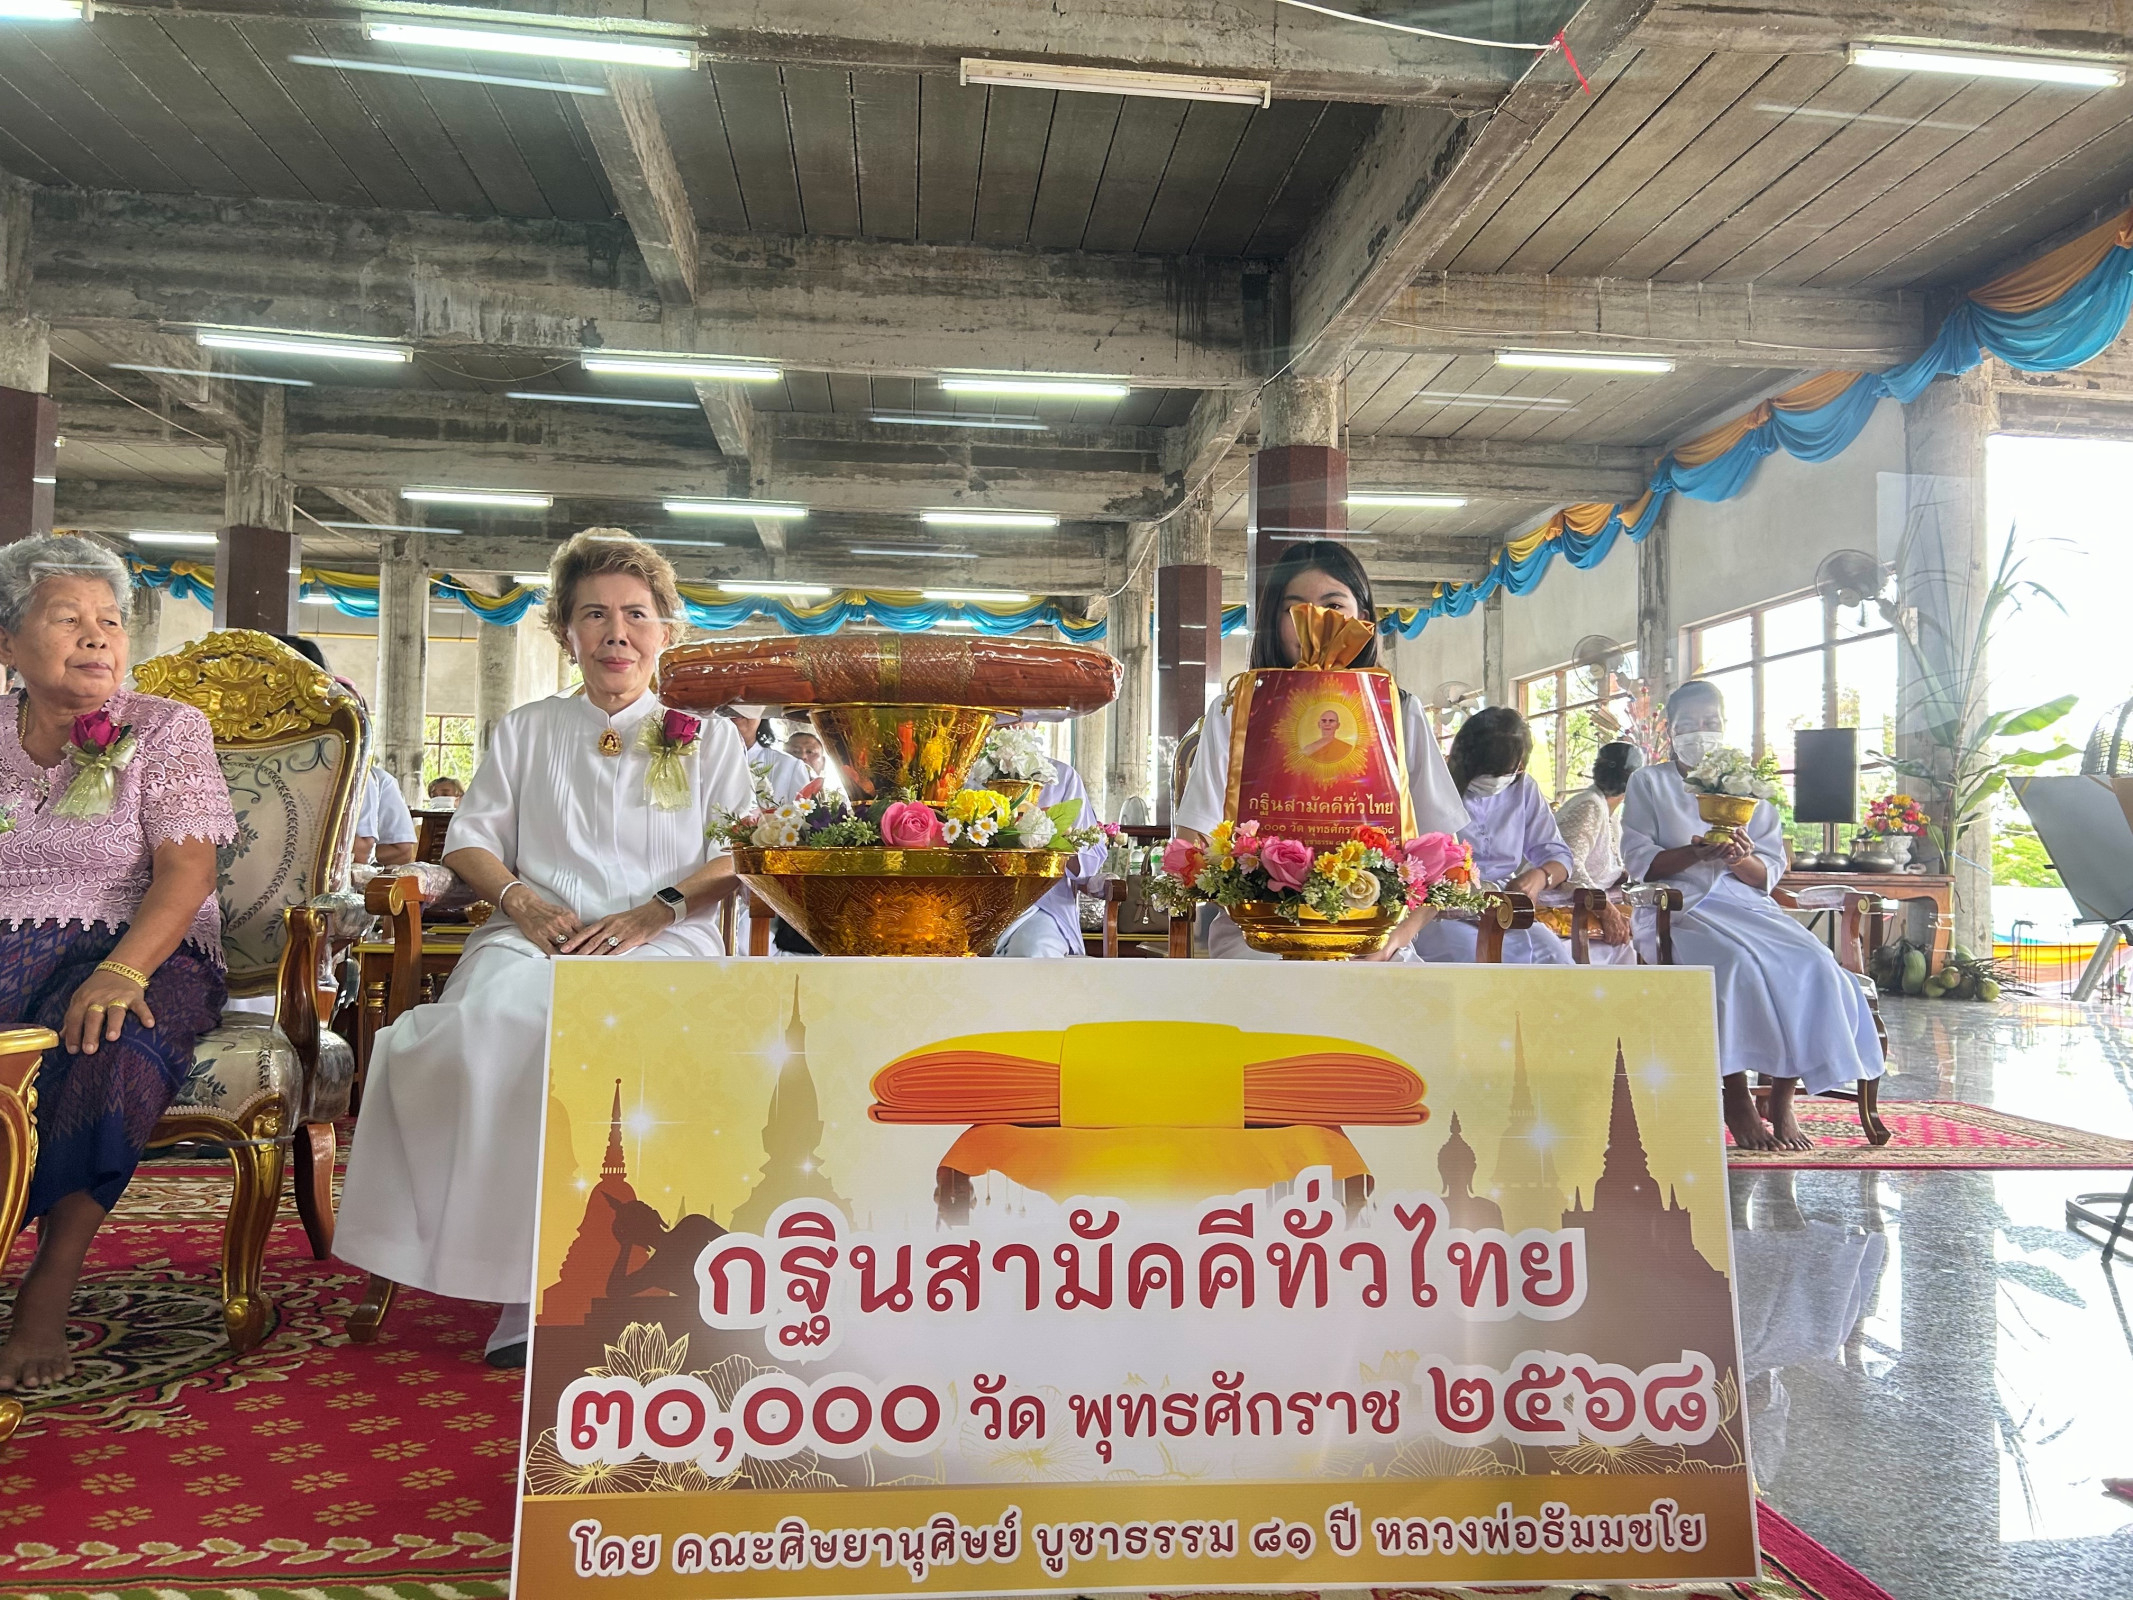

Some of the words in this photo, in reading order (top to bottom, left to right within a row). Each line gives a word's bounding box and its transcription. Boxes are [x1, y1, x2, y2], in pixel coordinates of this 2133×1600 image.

[1249, 792, 1394, 816] กฐินสามัคคีทั่วไทย
[1289, 821, 1304, 833] วัด
[708, 1179, 1574, 1347] กฐินสามัคคีทั่วไทย
[569, 1384, 942, 1463] ๓๐,๐๐๐
[970, 1373, 1047, 1440] วัด
[1068, 1370, 1401, 1464] พุทธศักราช
[1426, 1362, 1708, 1434] ๒๕๖๘
[574, 1524, 656, 1571] โดย
[677, 1511, 1018, 1575] คณะศิษยานุศิษย์
[1037, 1525, 1234, 1573] บูชาธรรม
[1253, 1523, 1311, 1554] ๘๑
[1330, 1507, 1358, 1551] ปี
[1376, 1503, 1703, 1551] หลวงพ่อธัมมชโย
